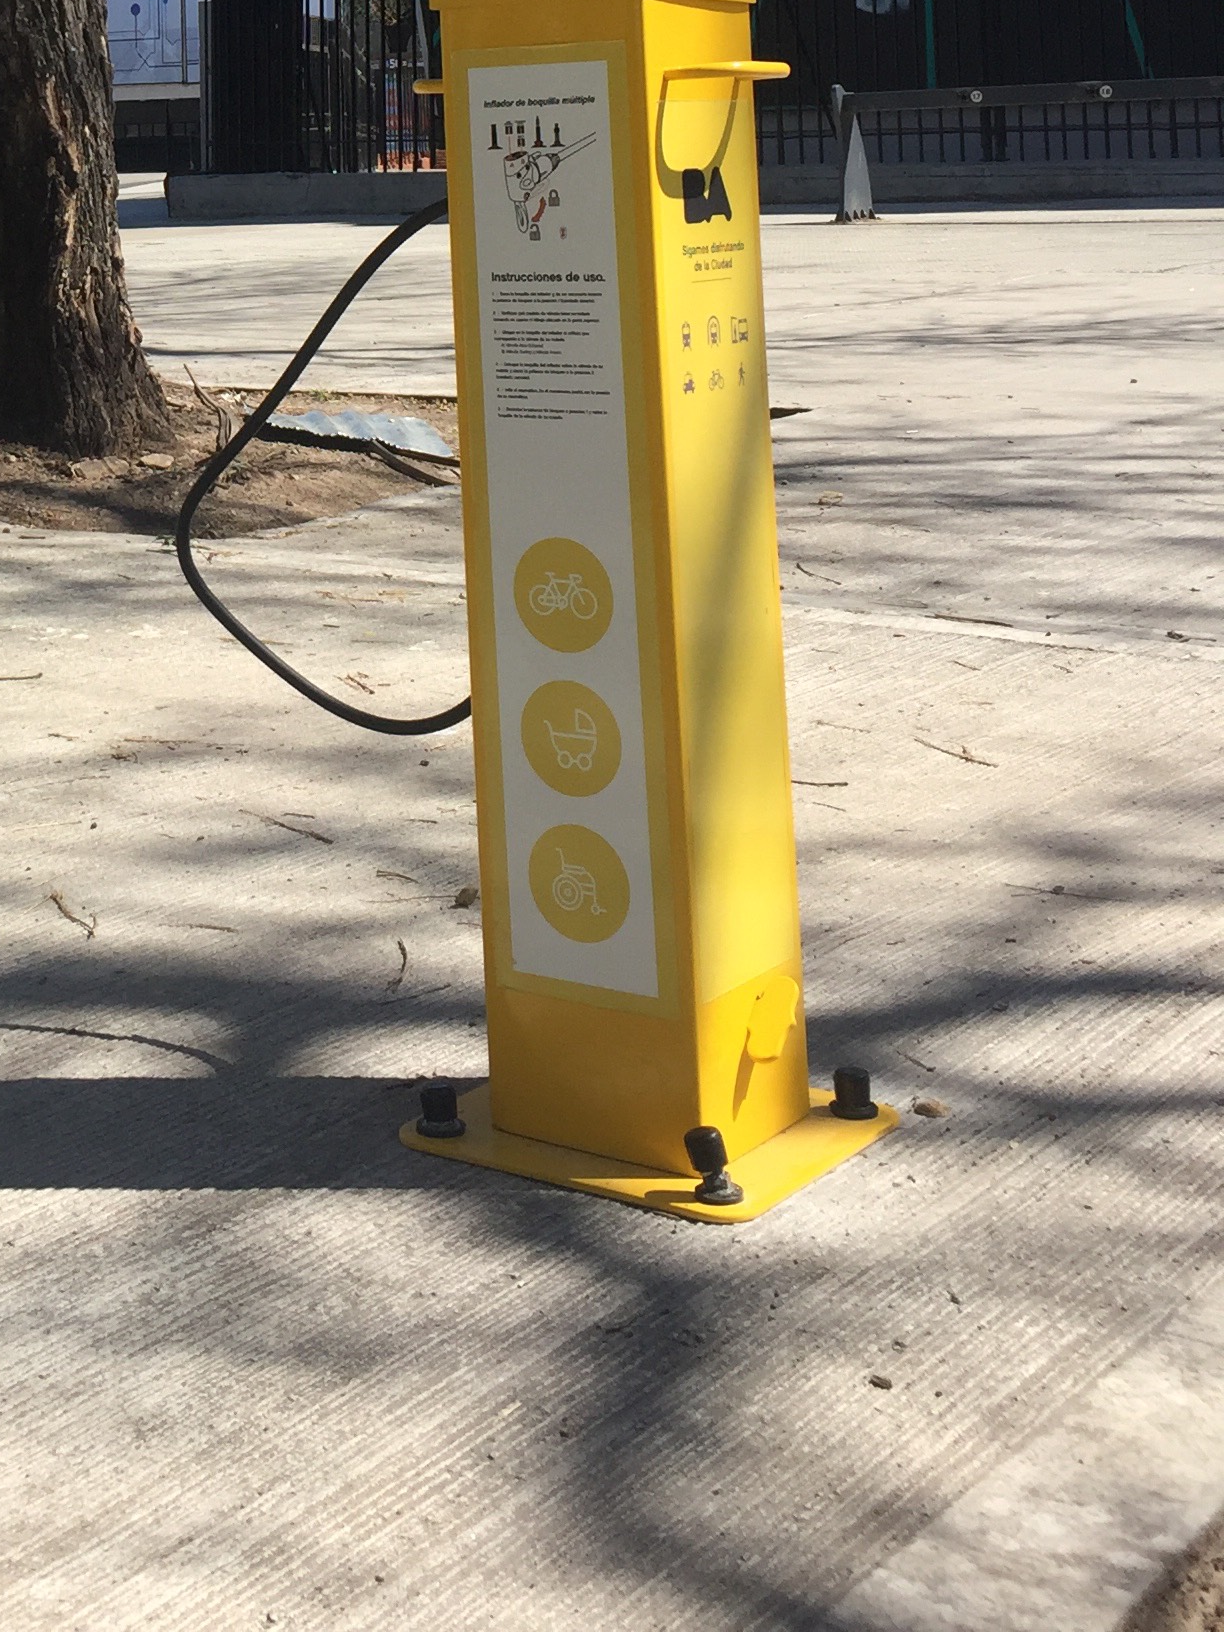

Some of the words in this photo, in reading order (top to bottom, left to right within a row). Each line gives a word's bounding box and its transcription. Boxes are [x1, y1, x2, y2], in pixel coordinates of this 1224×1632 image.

[515, 98, 526, 107] de
[682, 245, 709, 258] Sigamos
[694, 261, 702, 271] de
[704, 260, 710, 270] la
[711, 258, 733, 270] Ciudad
[491, 272, 562, 282] Instrucciones
[565, 271, 580, 282] de
